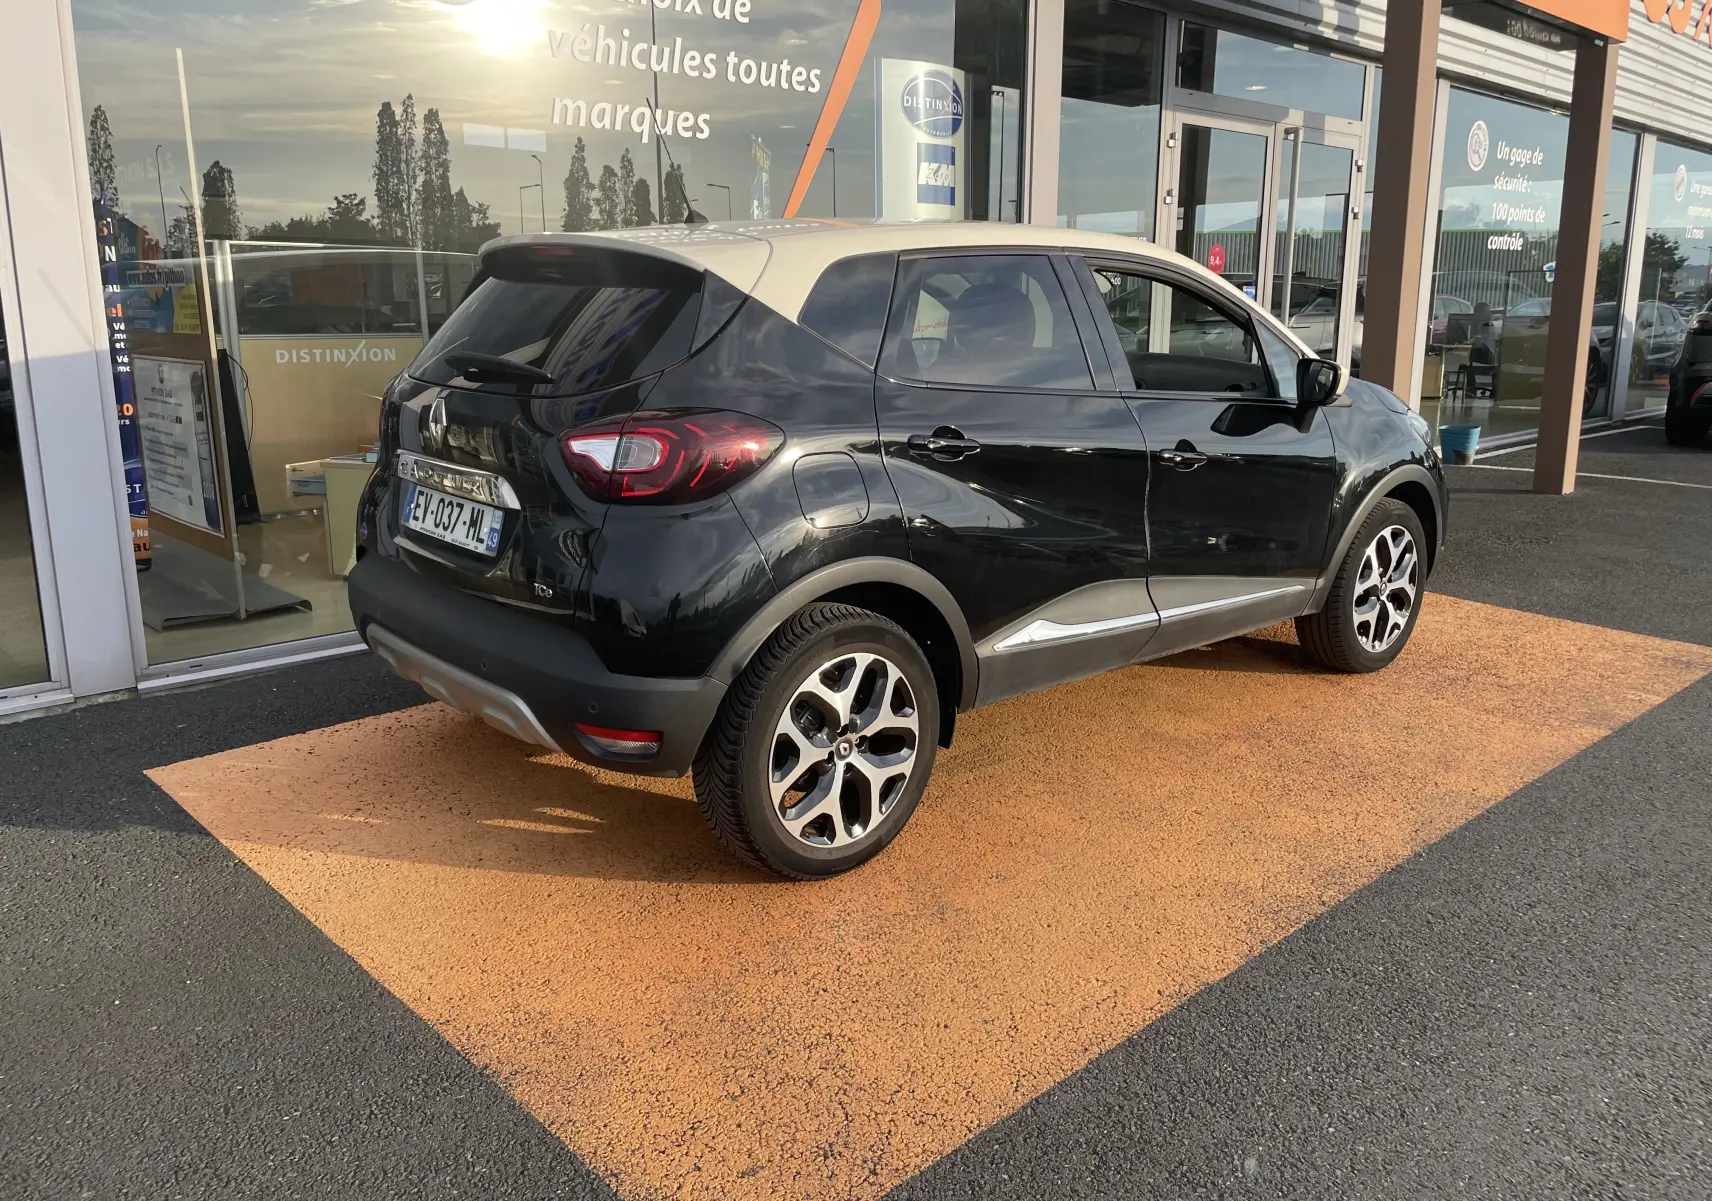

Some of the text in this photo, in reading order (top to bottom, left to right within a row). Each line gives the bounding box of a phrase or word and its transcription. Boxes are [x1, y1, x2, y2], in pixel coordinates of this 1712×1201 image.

[549, 23, 821, 93] véhicules toutes
[904, 95, 963, 116] DISTINXION
[552, 97, 711, 143] marques
[1497, 140, 1544, 168] Un gage de
[1491, 203, 1545, 224] 100 points de
[1487, 232, 1524, 251] contrôle
[275, 340, 396, 368] DISTINXION
[412, 489, 486, 544] EV-037-ML
[487, 530, 498, 549] 49
[533, 582, 553, 598] TCe
